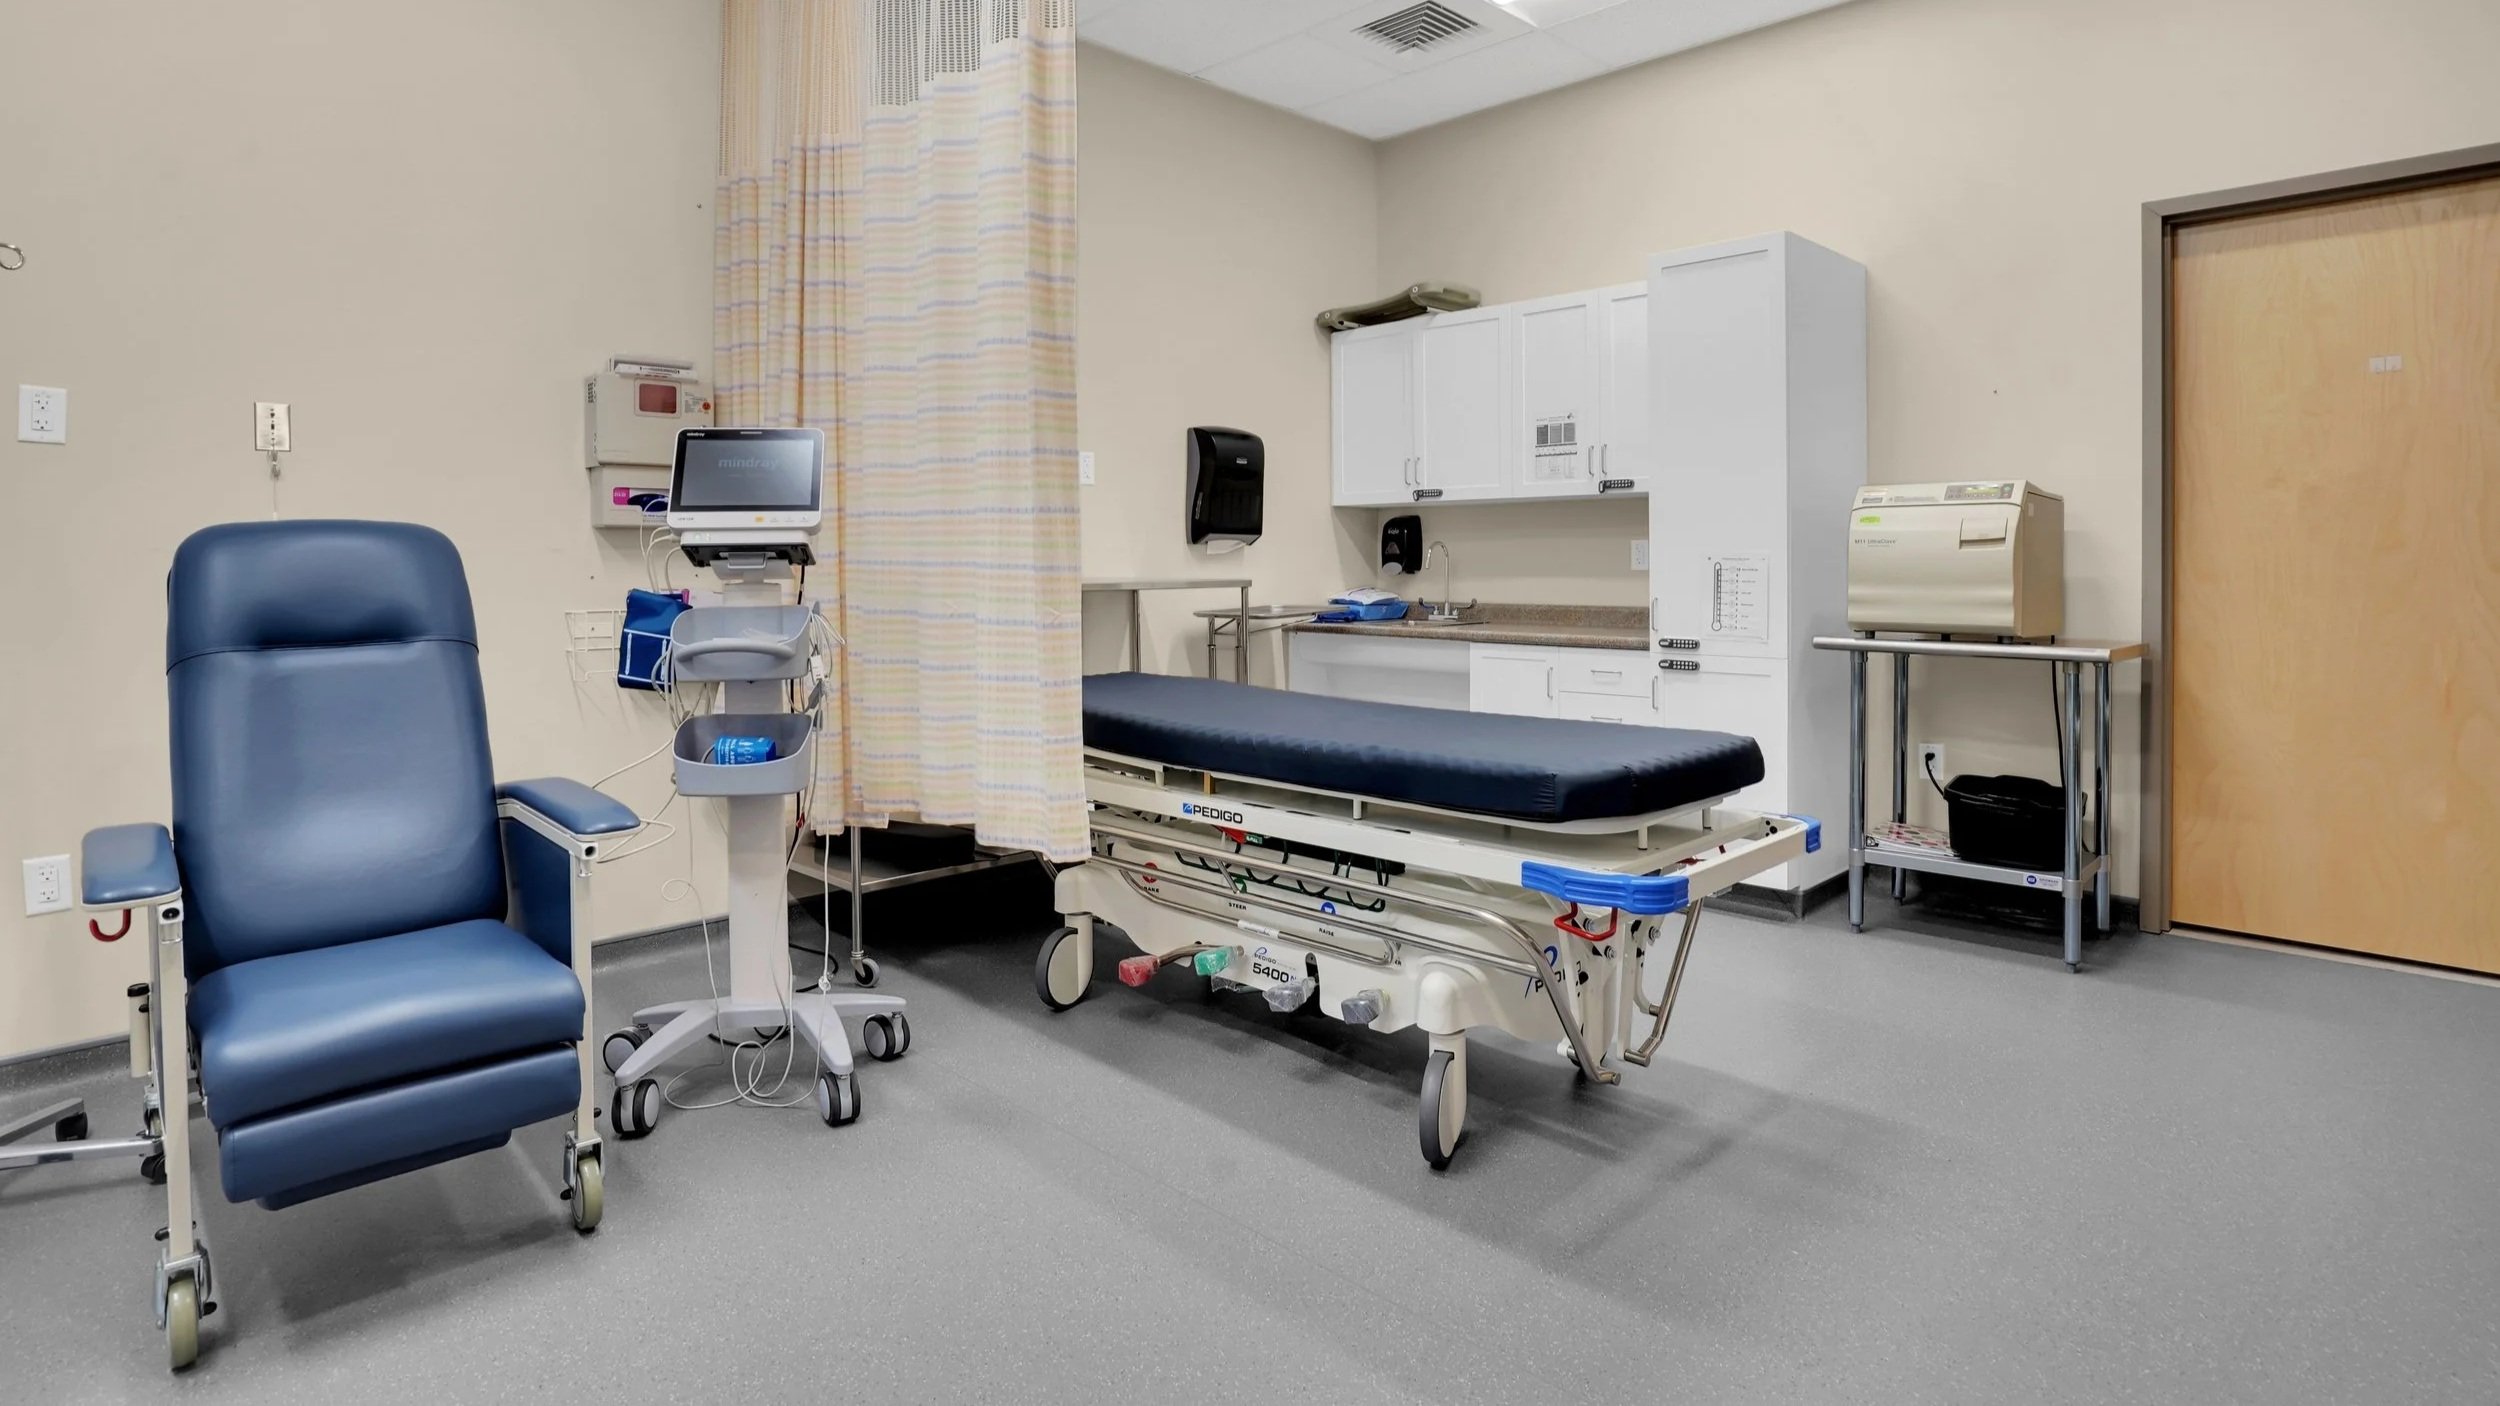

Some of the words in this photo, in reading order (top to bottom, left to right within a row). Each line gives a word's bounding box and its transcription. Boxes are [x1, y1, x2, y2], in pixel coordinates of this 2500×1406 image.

[718, 457, 779, 470] mindray
[1193, 804, 1243, 824] PEDIGO
[1228, 902, 1247, 910] STEER
[1318, 927, 1335, 937] RAISE
[1253, 952, 1277, 965] PEDIGO
[1252, 962, 1290, 983] 5400
